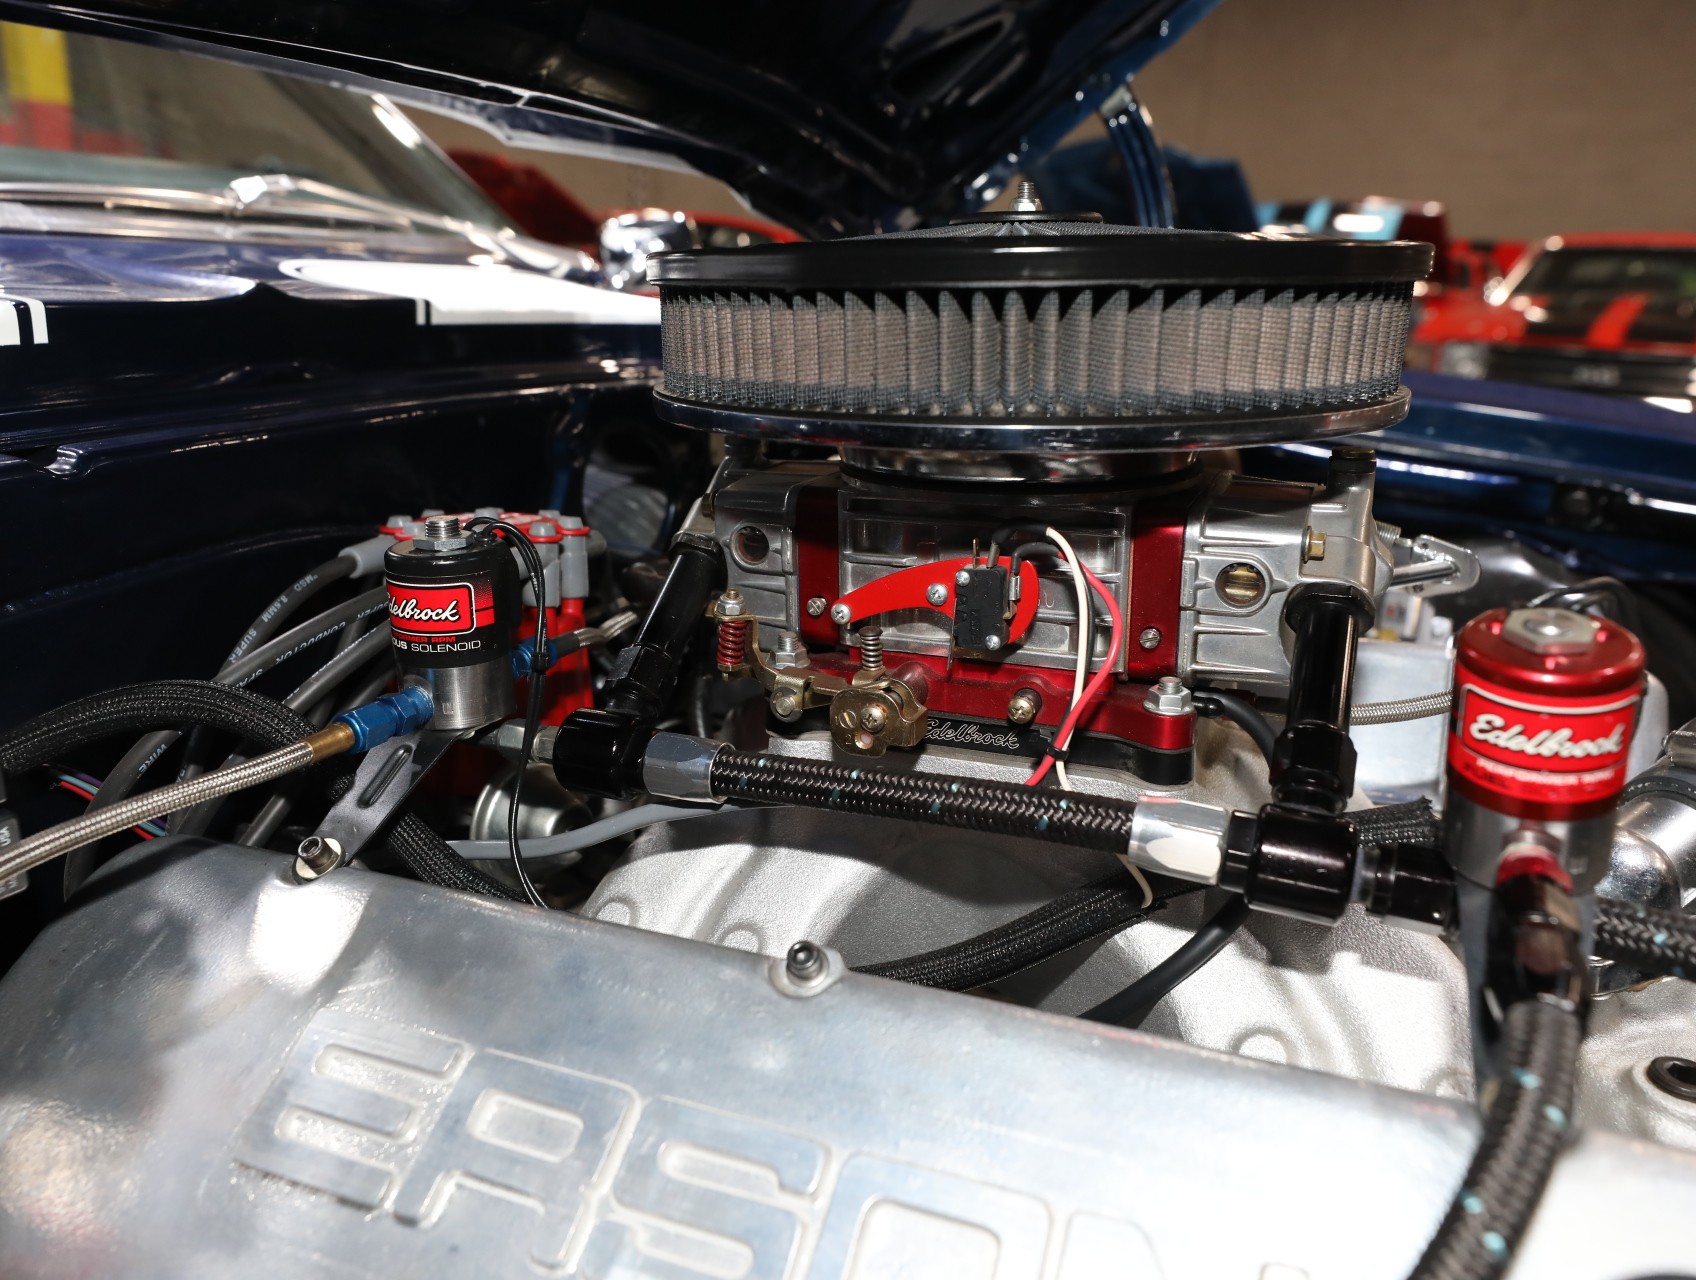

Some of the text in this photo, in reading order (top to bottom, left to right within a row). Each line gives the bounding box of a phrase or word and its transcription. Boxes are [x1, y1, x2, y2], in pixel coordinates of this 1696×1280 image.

[387, 592, 460, 622] delbrock
[410, 640, 482, 653] SOLENOID
[431, 635, 457, 643] RPM
[924, 718, 1020, 749] Edelbrock
[1469, 714, 1626, 757] Edelbrock
